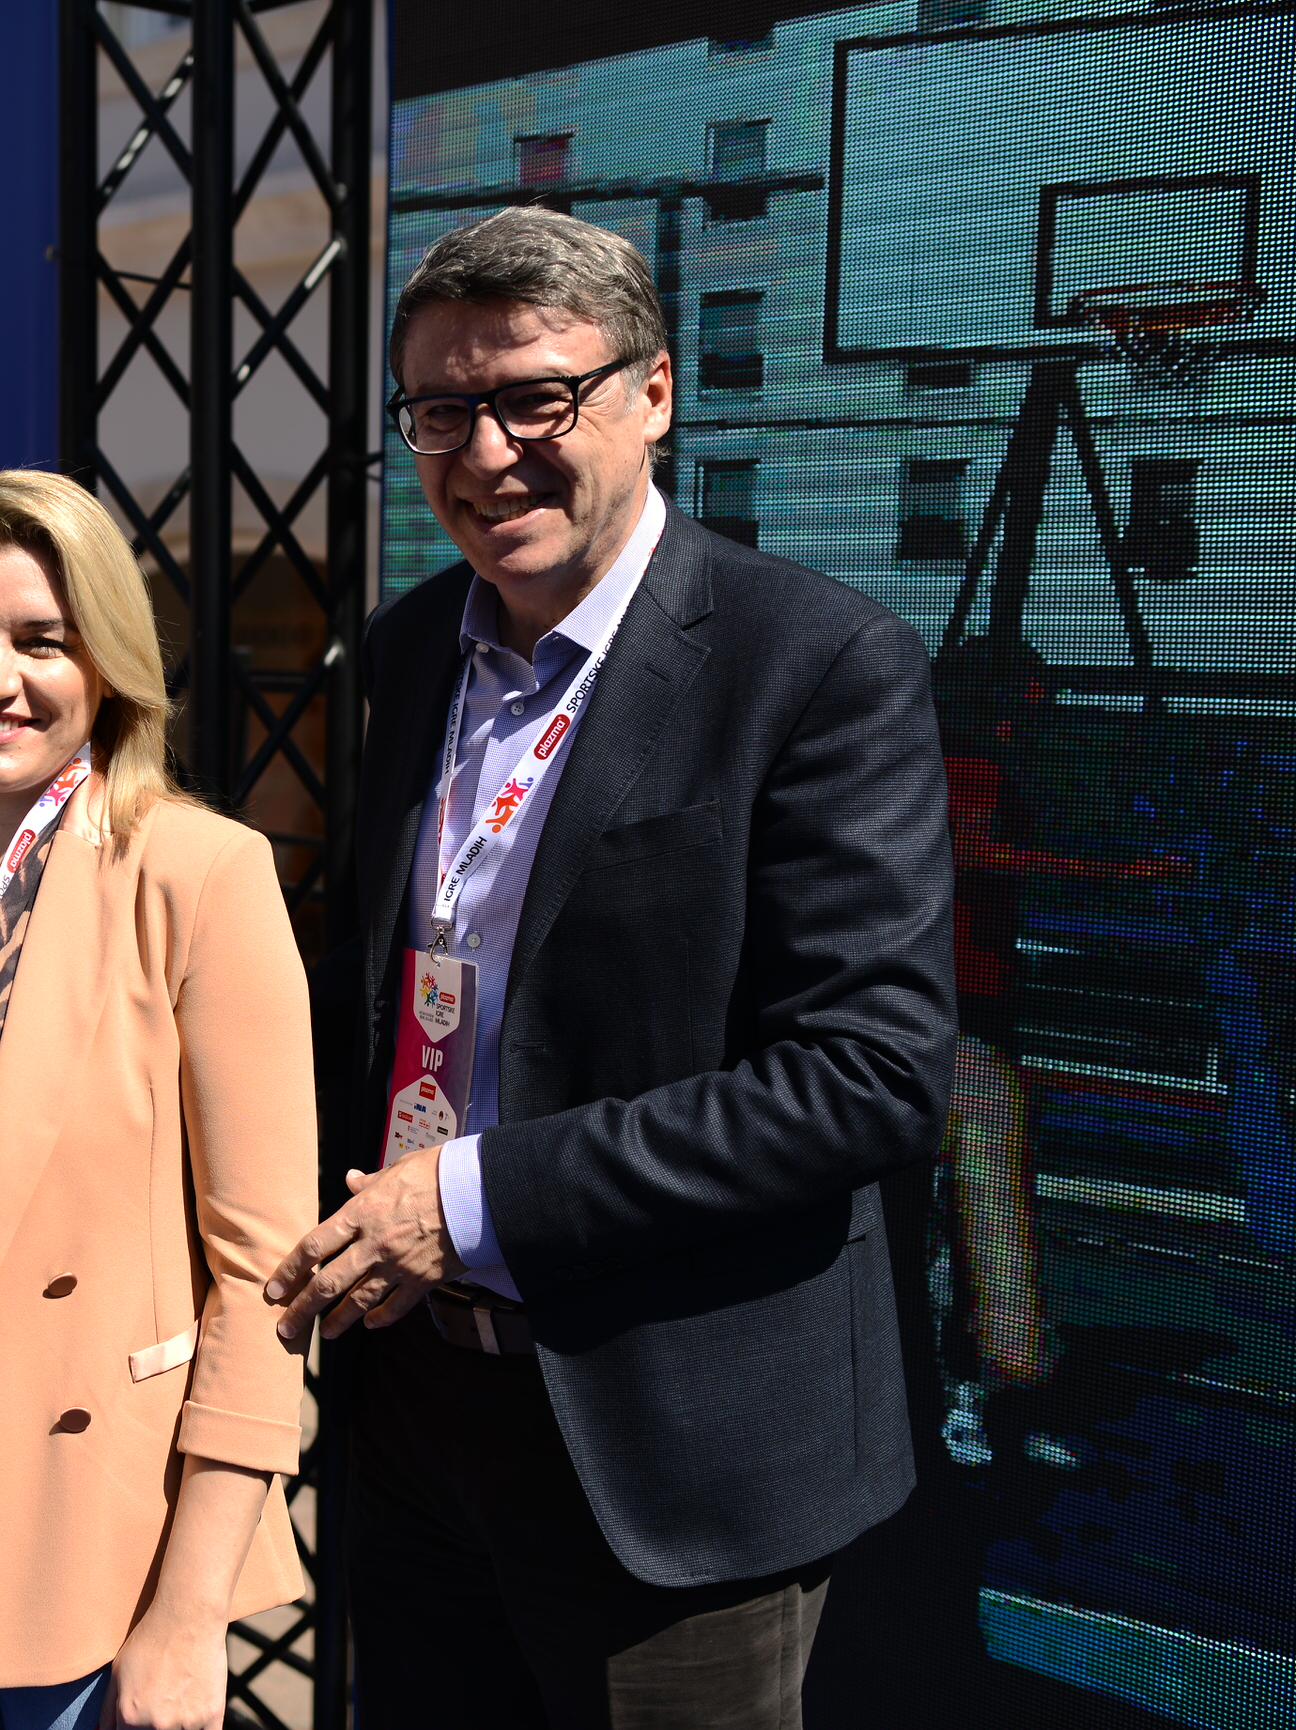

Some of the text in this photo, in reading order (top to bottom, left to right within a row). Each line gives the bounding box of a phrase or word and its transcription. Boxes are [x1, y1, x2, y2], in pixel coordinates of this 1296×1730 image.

[566, 656, 604, 714] SPORTSKE
[450, 703, 459, 728] IGRE
[444, 730, 455, 775] MLADIH
[537, 720, 566, 758] plazma
[9, 832, 32, 868] plazma
[444, 836, 487, 902] IGRE MLADIH
[422, 1044, 443, 1072] VIP
